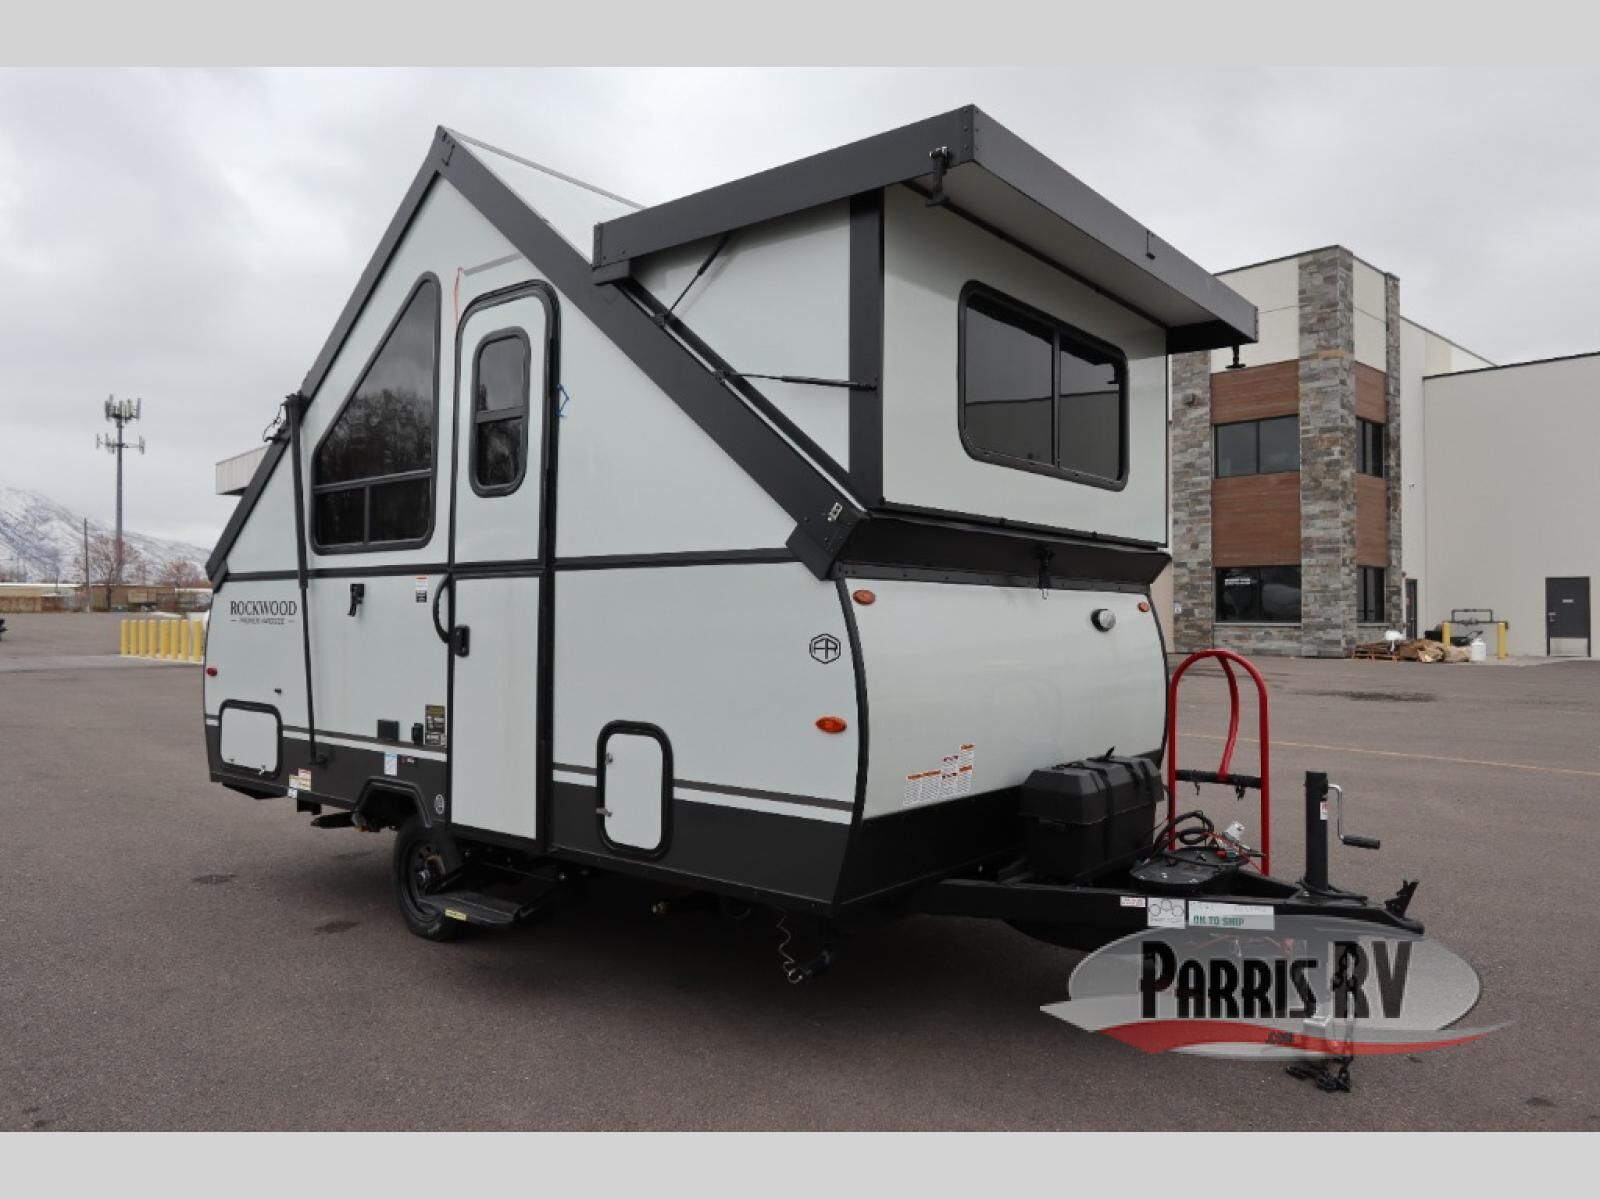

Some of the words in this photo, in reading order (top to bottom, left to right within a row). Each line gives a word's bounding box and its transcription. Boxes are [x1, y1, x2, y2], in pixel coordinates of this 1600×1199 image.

[230, 600, 298, 616] ROCKWOOD
[1193, 915, 1207, 926] OK
[1208, 915, 1220, 926] TO
[1222, 917, 1245, 927] SHIP
